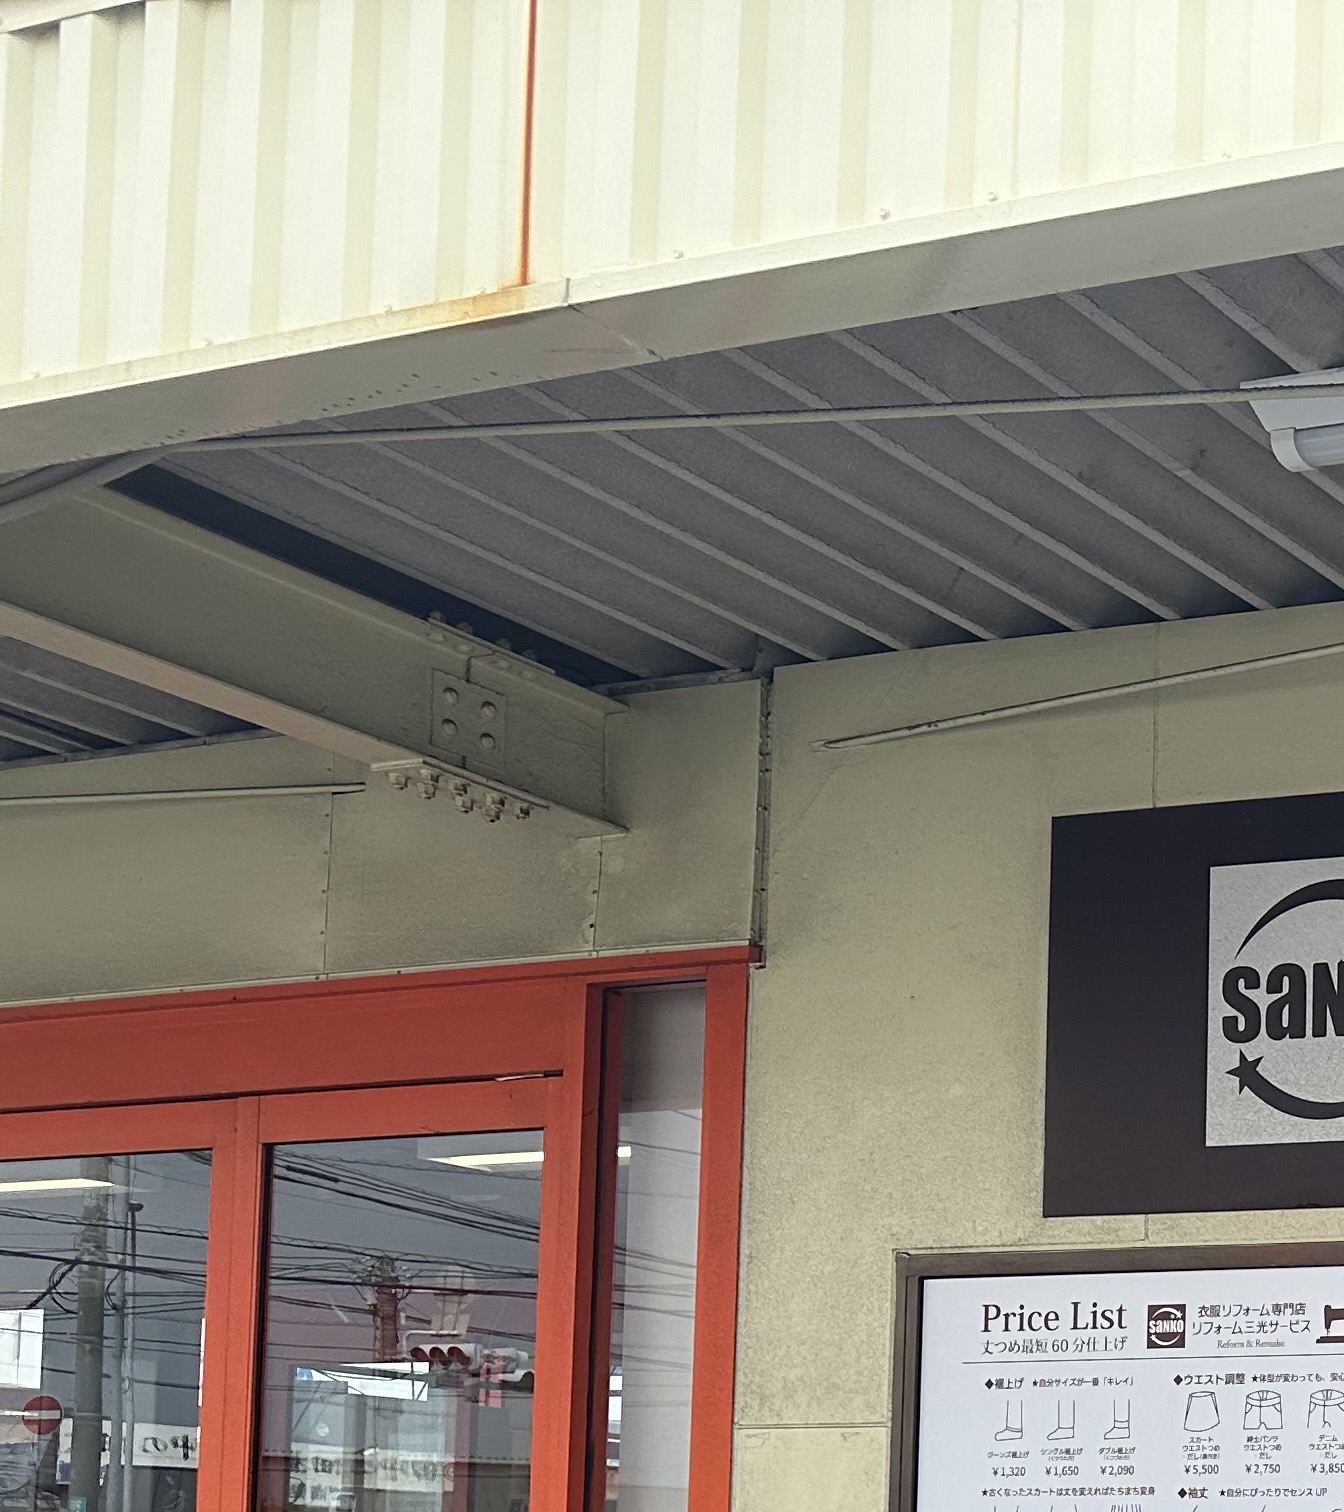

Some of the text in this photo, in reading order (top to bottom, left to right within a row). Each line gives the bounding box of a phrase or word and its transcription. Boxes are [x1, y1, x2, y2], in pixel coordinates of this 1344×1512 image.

[981, 1301, 1128, 1333] Price List
[1198, 1302, 1306, 1318] 衣服リフォーム専門店
[1192, 1320, 1311, 1335] リフォーム三光サービス
[1184, 1373, 1245, 1386] ウエスト調整
